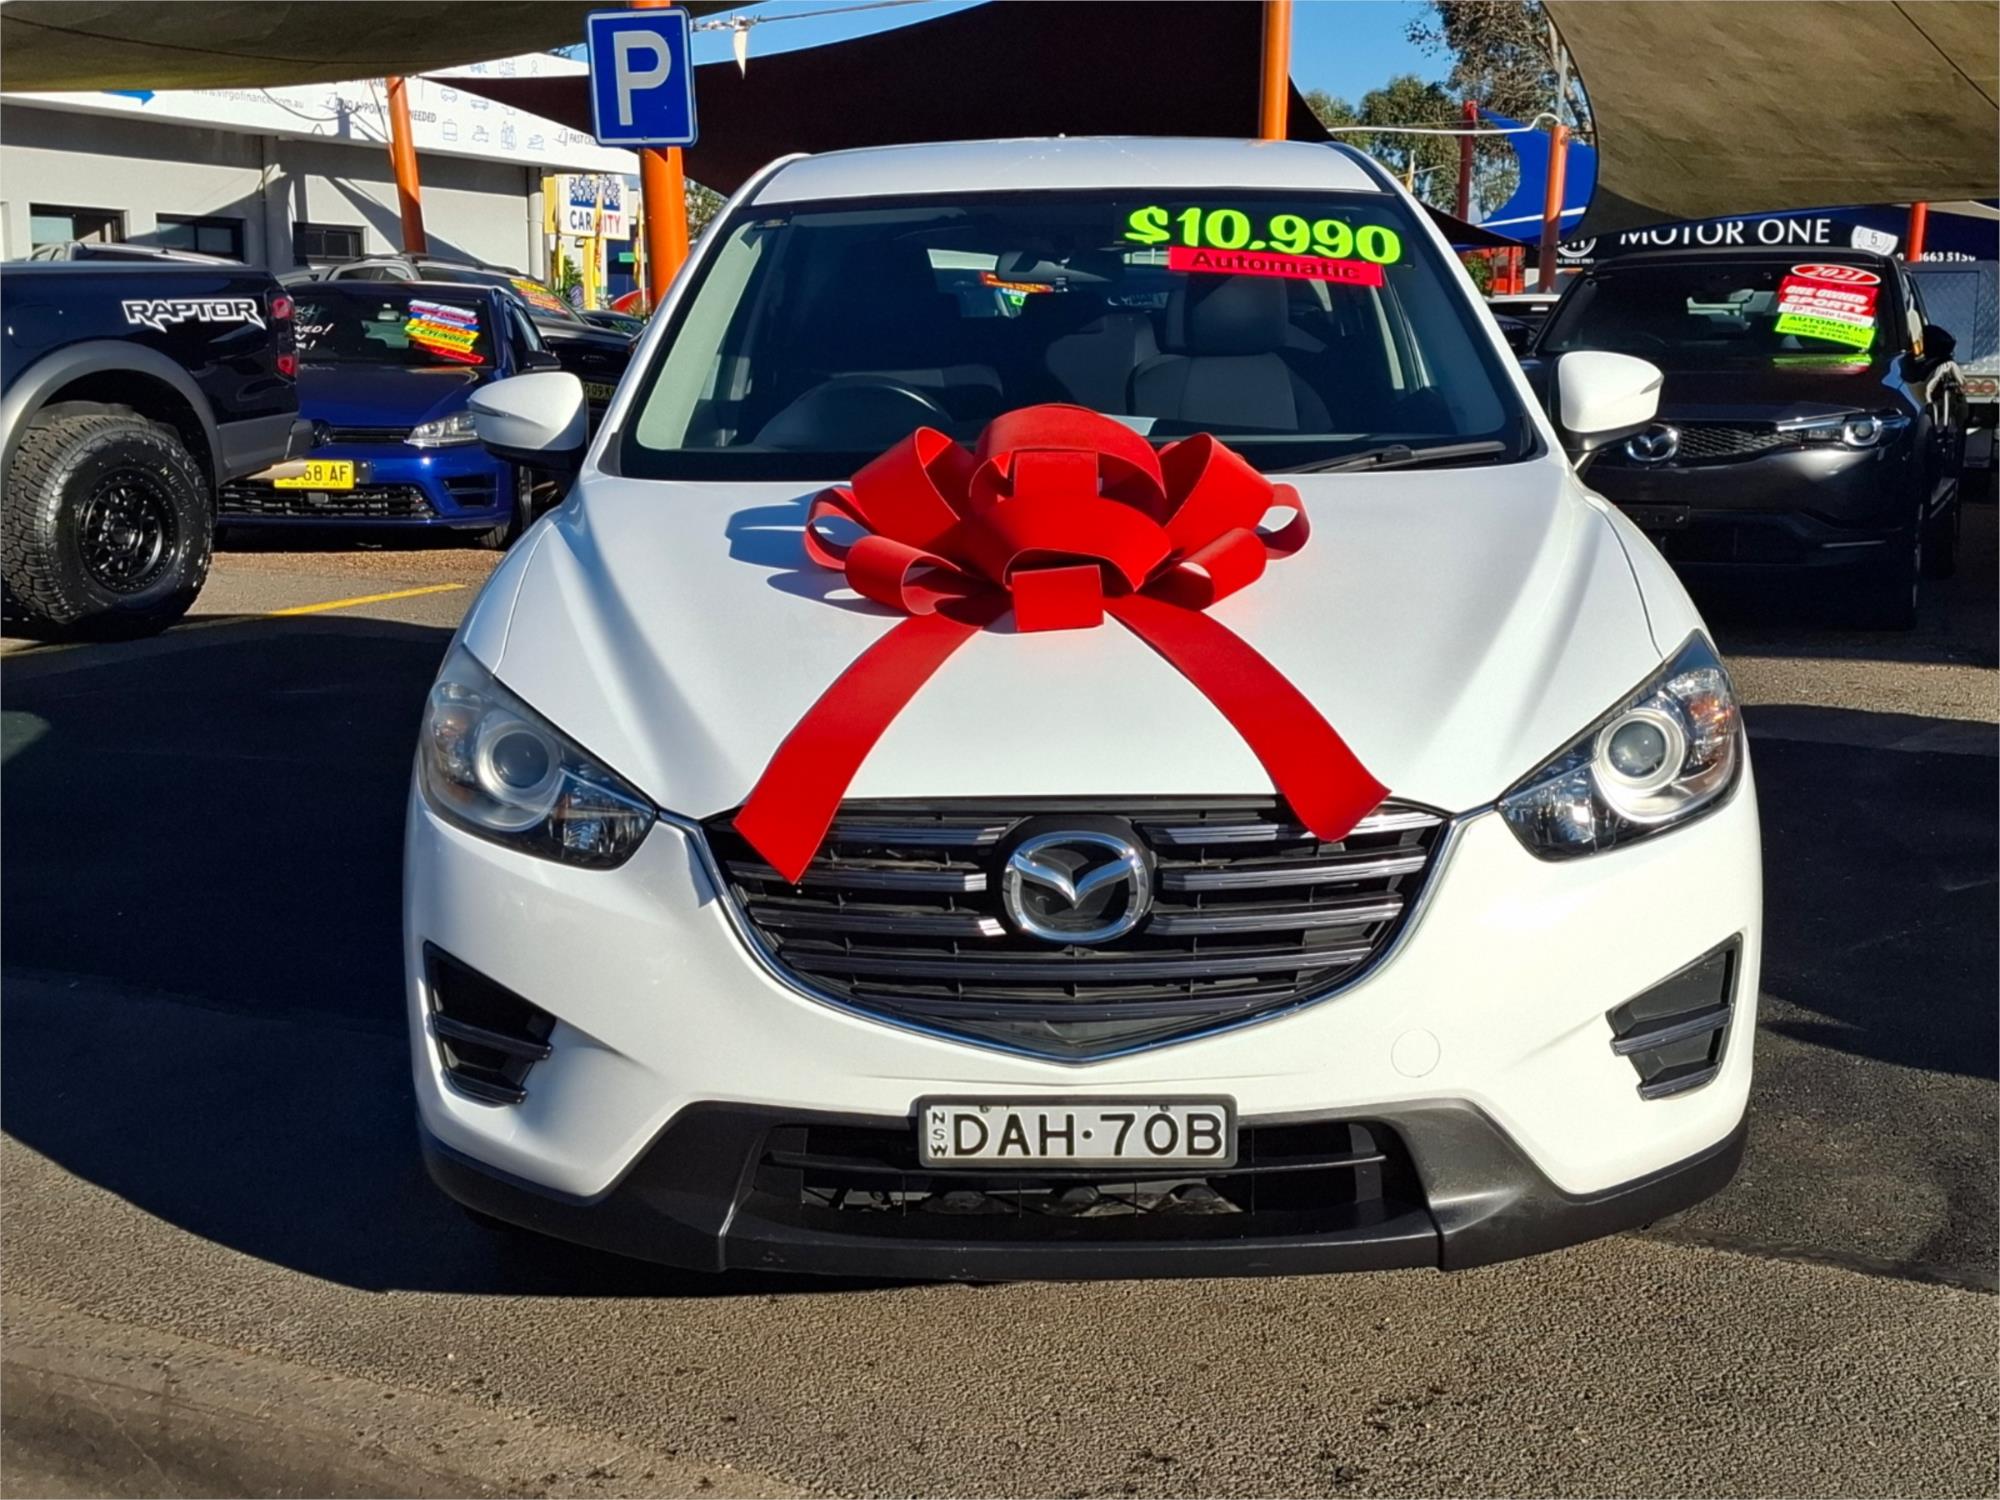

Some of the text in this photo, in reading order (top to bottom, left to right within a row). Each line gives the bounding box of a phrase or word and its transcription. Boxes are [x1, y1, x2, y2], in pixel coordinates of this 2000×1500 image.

[613, 30, 672, 126] P
[570, 210, 621, 234] CAR ITY
[1620, 220, 1745, 246] MOTOR
[1757, 218, 1831, 244] ONE
[1870, 231, 1878, 246] 5
[1191, 252, 1361, 280] Automatic
[1804, 265, 1865, 281] 2021
[1784, 295, 1870, 314] SPORTY
[121, 298, 267, 334] RAPTOR
[1789, 315, 1867, 333] AUTOMATIC
[329, 464, 349, 482] AF
